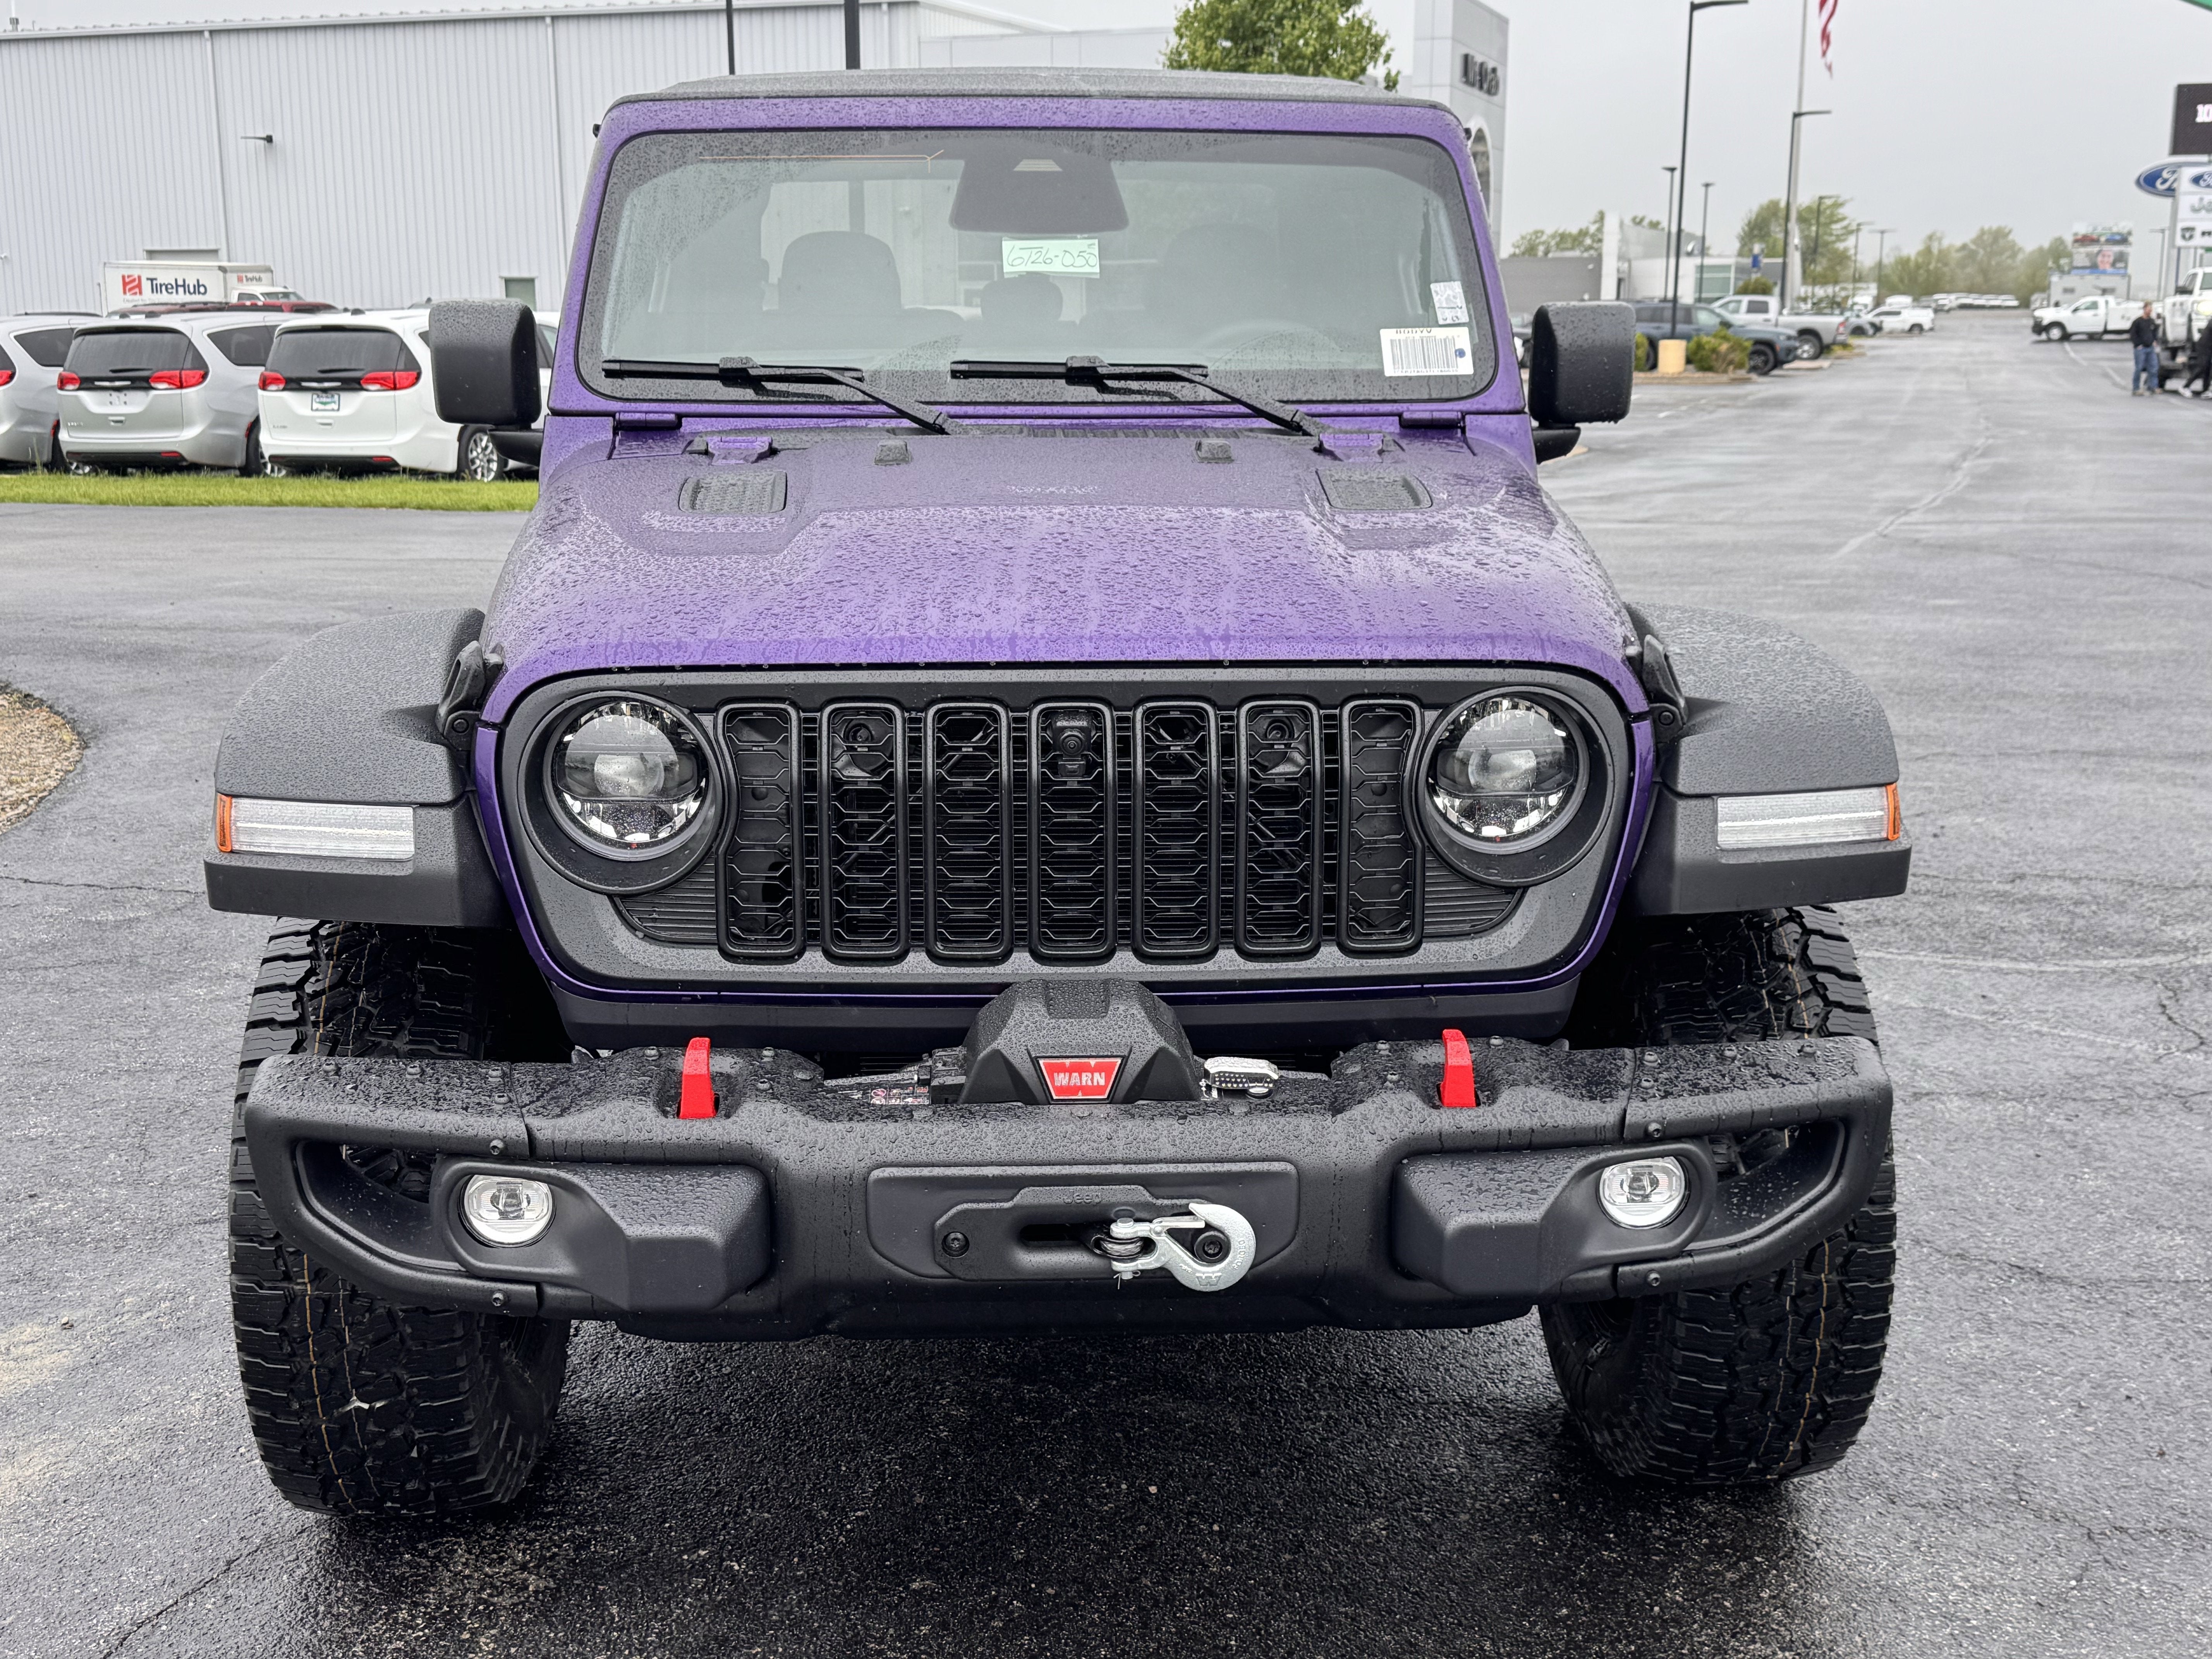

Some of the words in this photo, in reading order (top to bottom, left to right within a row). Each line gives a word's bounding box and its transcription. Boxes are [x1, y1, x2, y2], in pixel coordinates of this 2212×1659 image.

[146, 276, 207, 295] TireHub
[1054, 1072, 1105, 1086] WARN
[1063, 1190, 1102, 1206] Jeep
